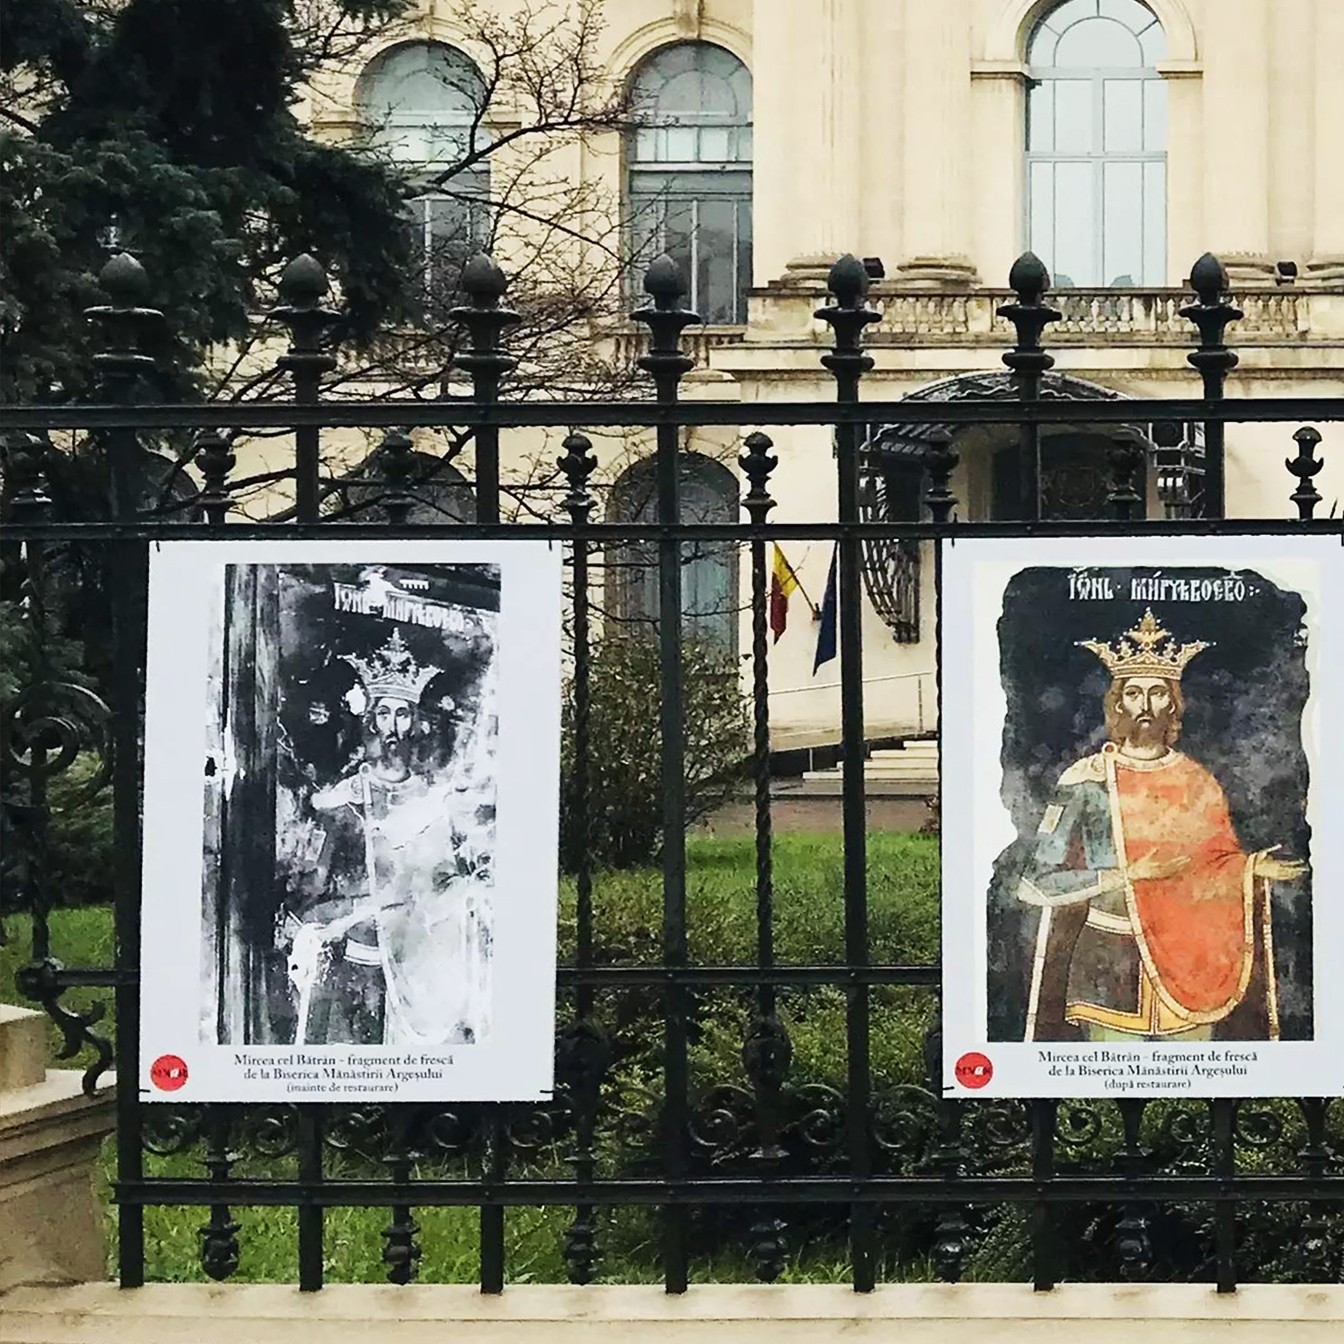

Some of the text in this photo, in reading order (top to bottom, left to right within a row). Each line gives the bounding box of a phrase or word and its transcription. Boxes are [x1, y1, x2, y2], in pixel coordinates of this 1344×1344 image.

[234, 1054, 275, 1065] Mircea
[277, 1054, 293, 1065] cel
[347, 1054, 400, 1069] fragment
[403, 1054, 418, 1065] de
[420, 1054, 454, 1065] frescă
[1039, 1051, 1079, 1062] Mircea
[1082, 1051, 1098, 1062] cel
[1152, 1050, 1204, 1065] fragment
[1207, 1050, 1221, 1062] de
[1224, 1050, 1258, 1062] frescă
[244, 1068, 258, 1079] de
[260, 1068, 270, 1079] la
[273, 1068, 319, 1079] Biserica
[1048, 1065, 1062, 1076] de
[1065, 1065, 1075, 1076] la
[1078, 1065, 1124, 1076] Biserica
[328, 1082, 341, 1092] de
[343, 1082, 399, 1093] restaurare)
[1104, 1079, 1191, 1092] (după restaurare)
